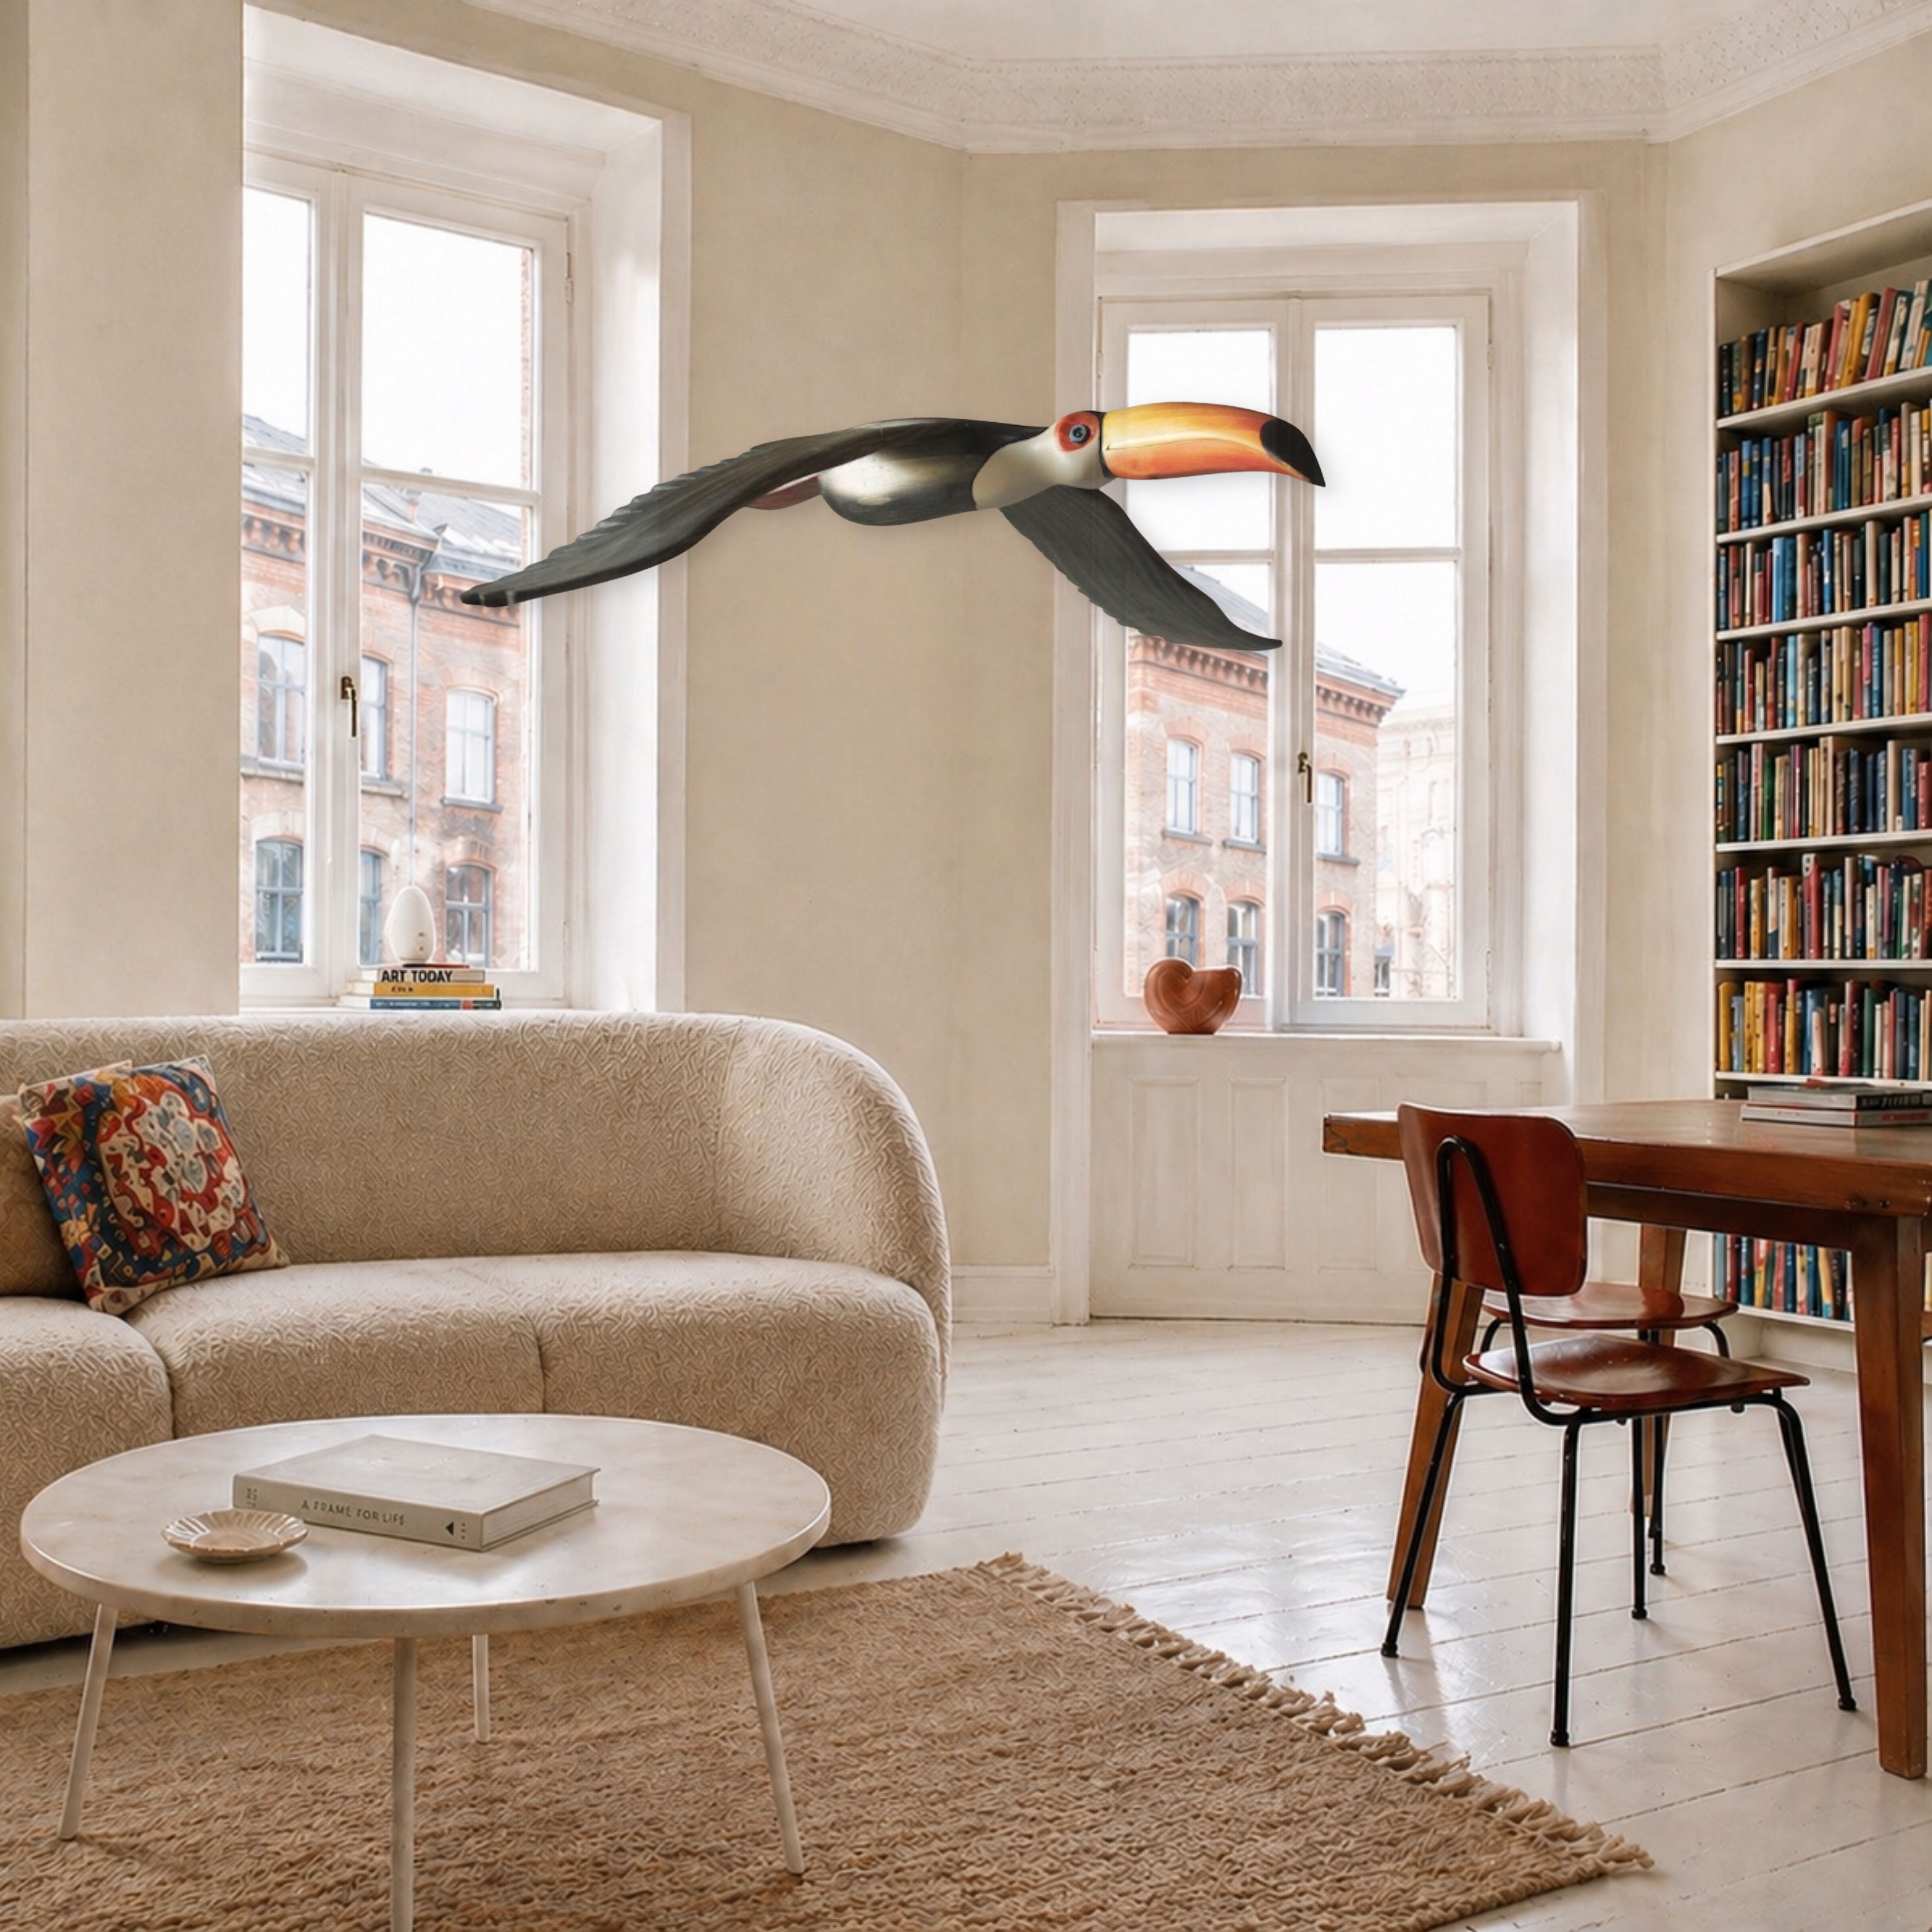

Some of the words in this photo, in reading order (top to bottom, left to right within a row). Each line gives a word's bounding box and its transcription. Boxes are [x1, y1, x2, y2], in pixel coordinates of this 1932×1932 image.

[381, 970, 407, 983] ART
[412, 970, 452, 983] TODAY
[301, 1500, 309, 1510] A
[356, 1508, 379, 1520] FOR
[382, 1513, 405, 1526] LIFE
